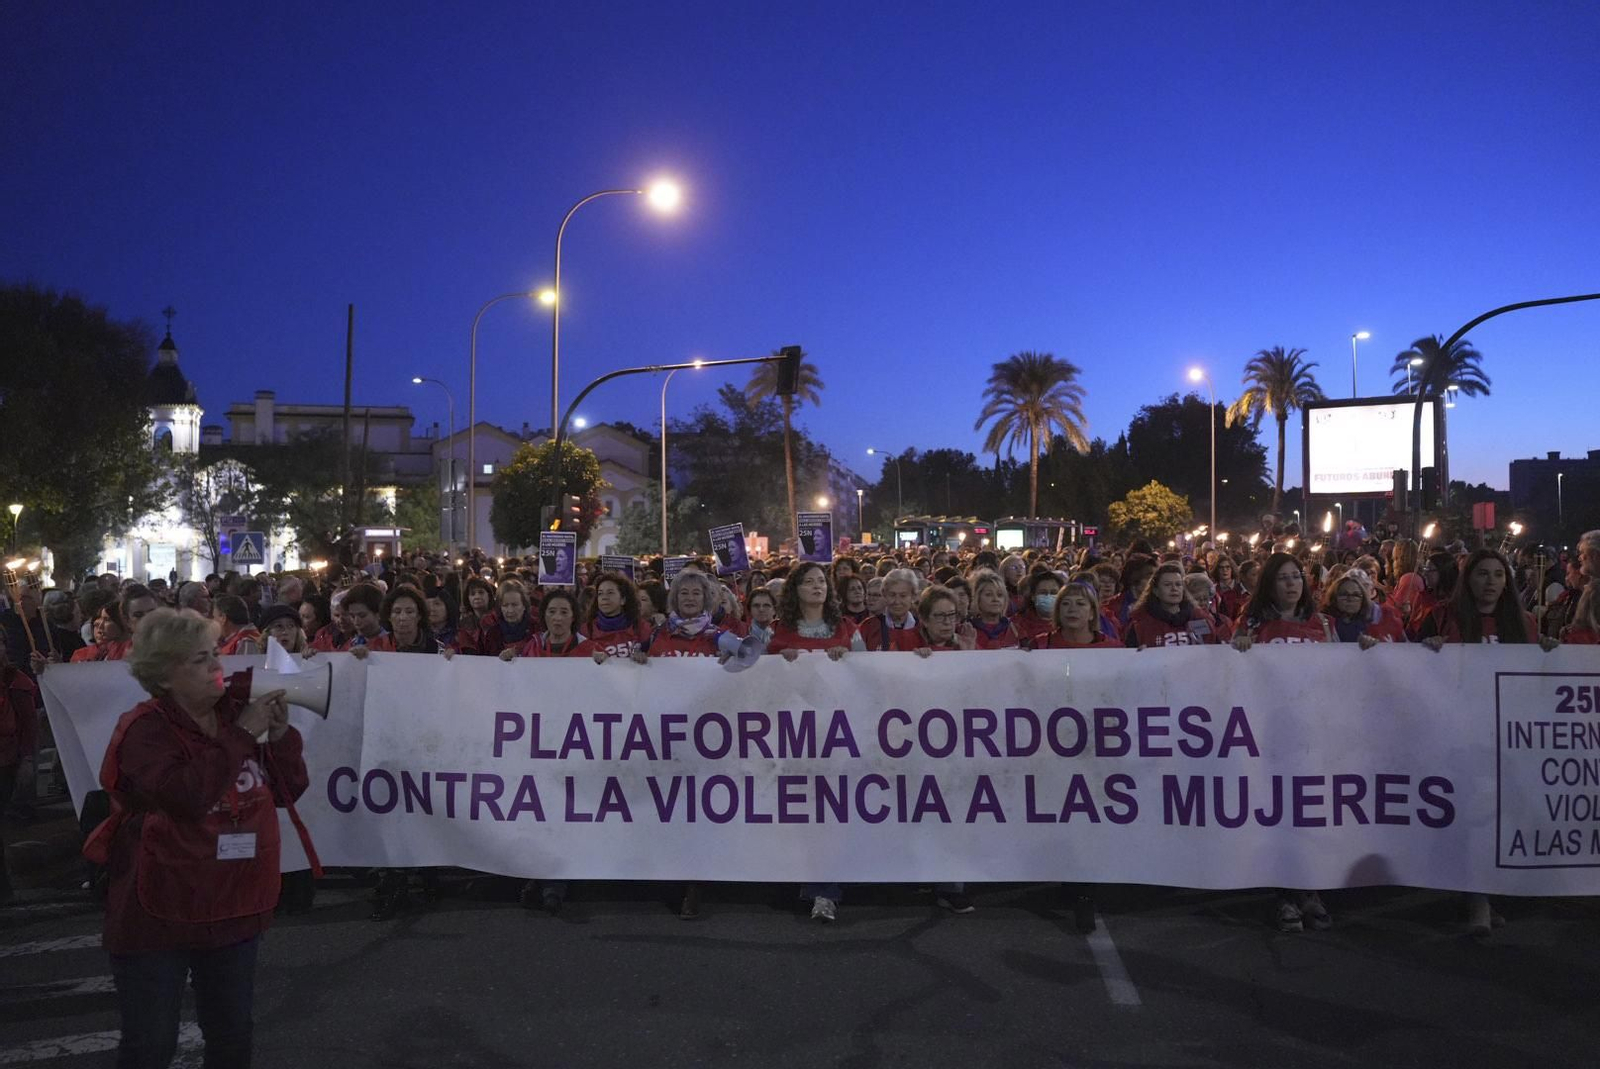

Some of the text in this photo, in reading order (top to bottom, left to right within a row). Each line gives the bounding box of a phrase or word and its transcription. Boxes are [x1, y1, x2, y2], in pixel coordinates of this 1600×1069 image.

[713, 542, 727, 551] 25N
[494, 706, 1260, 761] PLATAFORMA CORDOBESA
[327, 766, 1456, 829] CONTRA LA VIOLENCIA A LAS MUJERES
[1508, 829, 1528, 857] A
[1534, 829, 1583, 856] LAS
